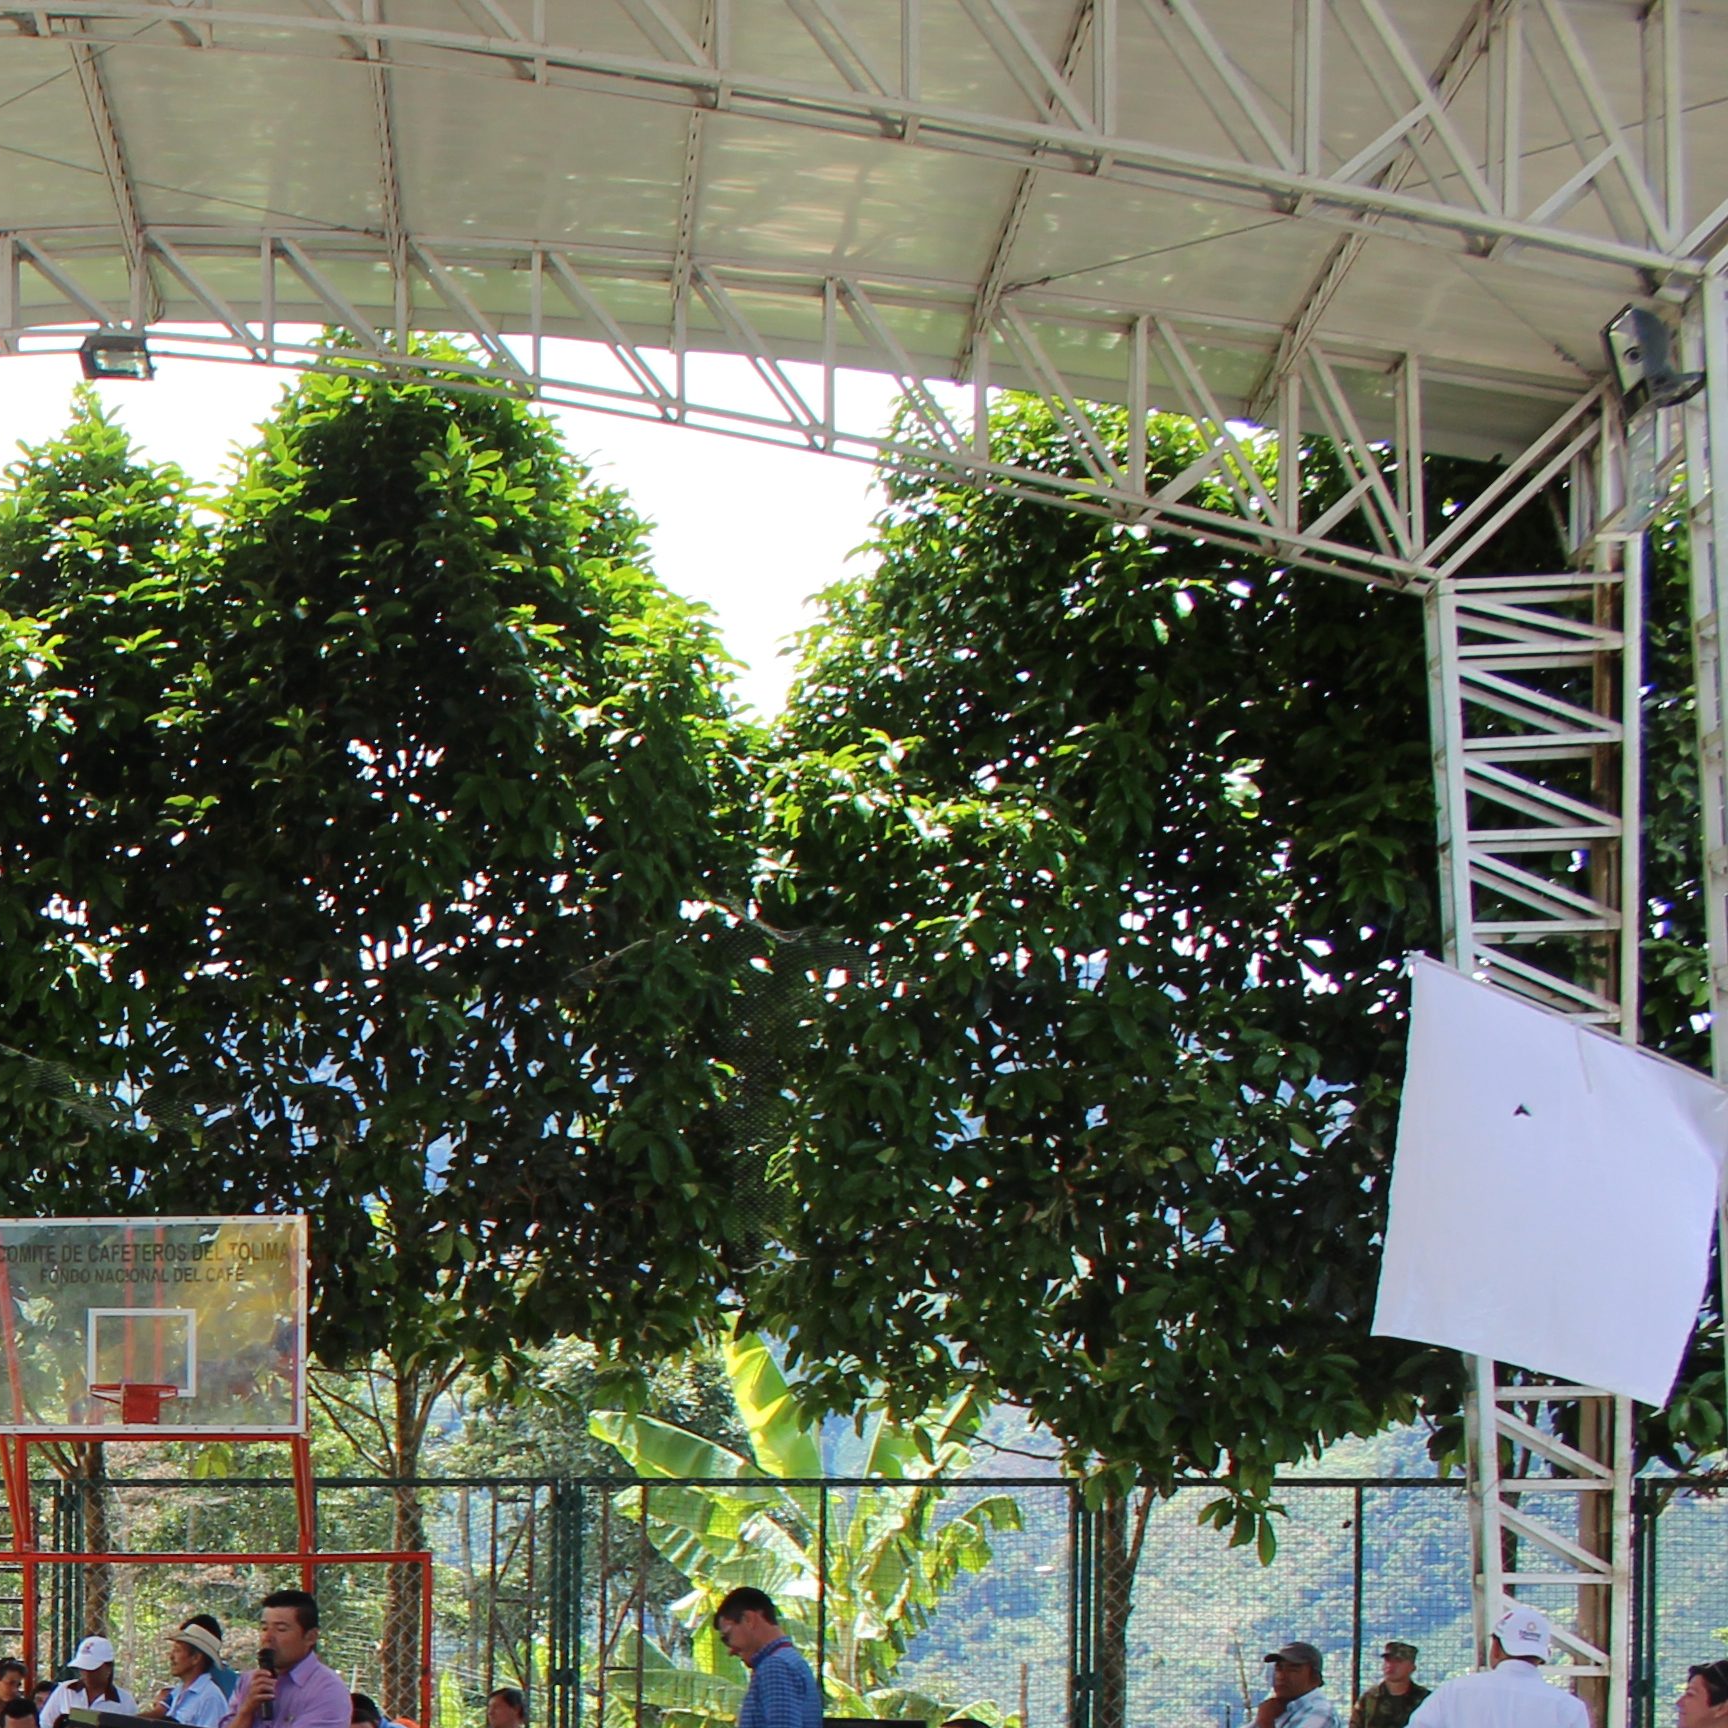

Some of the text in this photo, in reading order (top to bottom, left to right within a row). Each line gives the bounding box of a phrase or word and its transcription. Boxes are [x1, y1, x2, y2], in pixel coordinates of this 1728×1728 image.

[61, 1244, 84, 1262] DE
[87, 1243, 187, 1262] CAFETEROS
[192, 1242, 223, 1261] DEL
[229, 1242, 290, 1261] TOLIMA
[40, 1268, 91, 1283] FONDO
[94, 1267, 169, 1283] NACIONAL
[173, 1267, 202, 1282] DEL
